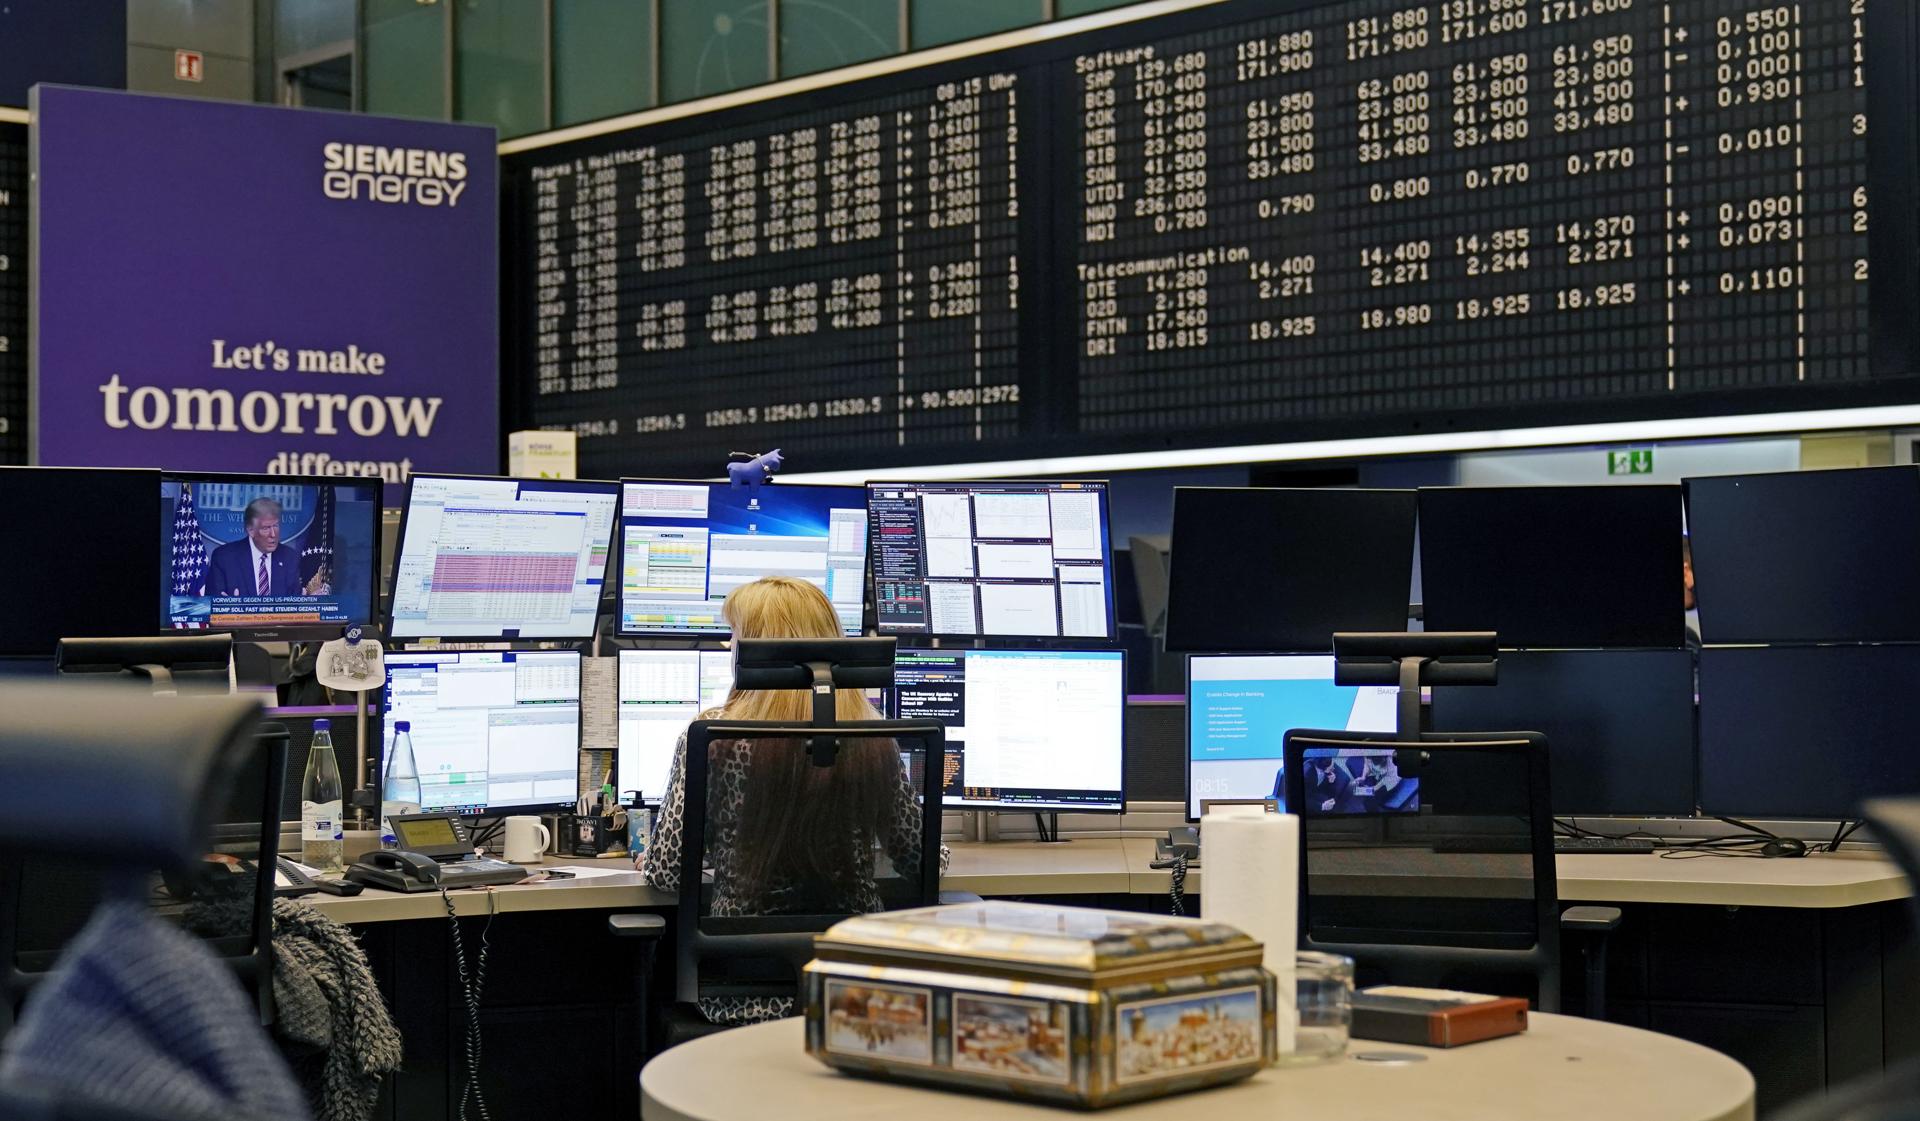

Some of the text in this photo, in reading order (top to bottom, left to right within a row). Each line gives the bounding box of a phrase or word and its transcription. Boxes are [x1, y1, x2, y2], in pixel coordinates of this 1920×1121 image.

[1076, 45, 1154, 73] Software
[1086, 7, 1427, 89] SAP 129,680 131,880 131,880
[1136, 71, 1204, 99] 170,400
[1238, 50, 1312, 80] 171,900
[1348, 28, 1427, 59] 171,900
[1442, 9, 1526, 42] 171,600
[937, 77, 982, 101] 08:15
[989, 73, 1018, 91] Uhr
[1086, 0, 1863, 146] NEM 61,400 61,950 62,000 61,950 61,950 0,550 2
[930, 97, 972, 120] 1,300
[1008, 89, 1015, 105] 1
[1086, 18, 1862, 165] RIB 23,900 23,800 23,800 23,800 23,800 0,100 1
[1145, 91, 1204, 117] 43,540
[928, 115, 972, 138] 0,610
[1008, 107, 1015, 124] 1
[1145, 150, 1205, 175] 41,500
[1248, 132, 1312, 159] 41,500
[1359, 113, 1428, 141] 41,500
[1454, 97, 1527, 125] 41,500
[1554, 79, 1632, 109] 41,500
[1718, 54, 1788, 83] 0,000
[1854, 42, 1862, 61] 1
[930, 133, 972, 156] 1,350
[1007, 125, 1017, 143] 2
[1086, 66, 1862, 203] UTDI 32,550 33,480 33,480 33,480 33,480 0,930 1
[323, 142, 467, 180] SIEMENS
[929, 151, 972, 174] 0,700
[1009, 145, 1015, 161] 1
[1155, 209, 1205, 232] 0,780
[1259, 193, 1313, 217] 0,790
[1371, 177, 1428, 202] 0,800
[1466, 162, 1527, 188] 0,770
[1568, 147, 1632, 174] 0,770
[1719, 125, 1790, 153] 0,010
[1853, 114, 1865, 134] 3
[929, 170, 973, 192] 0,615
[1009, 163, 1016, 179] 1
[930, 188, 972, 210] 1,300
[1009, 182, 1016, 198] 1
[1136, 189, 1205, 215] 236,000
[929, 206, 973, 228] 0,200
[1008, 199, 1017, 216] 2
[1087, 186, 1866, 298] DTE 14,280 14,400 14,400 14,355 14,370 0,090 6
[929, 261, 973, 282] 0,340
[1010, 256, 1016, 271] 1
[1078, 246, 1249, 281] Telecommunication
[1156, 288, 1206, 309] 2,198
[1260, 276, 1311, 298] 2,271
[1372, 262, 1427, 285] 2,271
[1467, 250, 1528, 274] 2,244
[1569, 238, 1631, 263] 2,271
[1720, 219, 1790, 246] 0,073
[1854, 210, 1866, 231] 2
[930, 279, 973, 299] 3,700
[1009, 273, 1018, 290] 3
[929, 297, 973, 318] 0,220
[1010, 293, 1016, 308] 1
[1088, 259, 1867, 355] DRI 18,815 18,925 18,980 18,925 18,925 0,110 2
[1087, 308, 1206, 335] FNTN 17,560
[211, 339, 386, 375] Let's make
[99, 373, 443, 437] tomorrow
[921, 388, 973, 408] 90,500
[982, 384, 1018, 403] 2972
[267, 451, 413, 484] different
[212, 596, 242, 604] VORWÜRFE
[1195, 777, 1229, 793] 08:15
